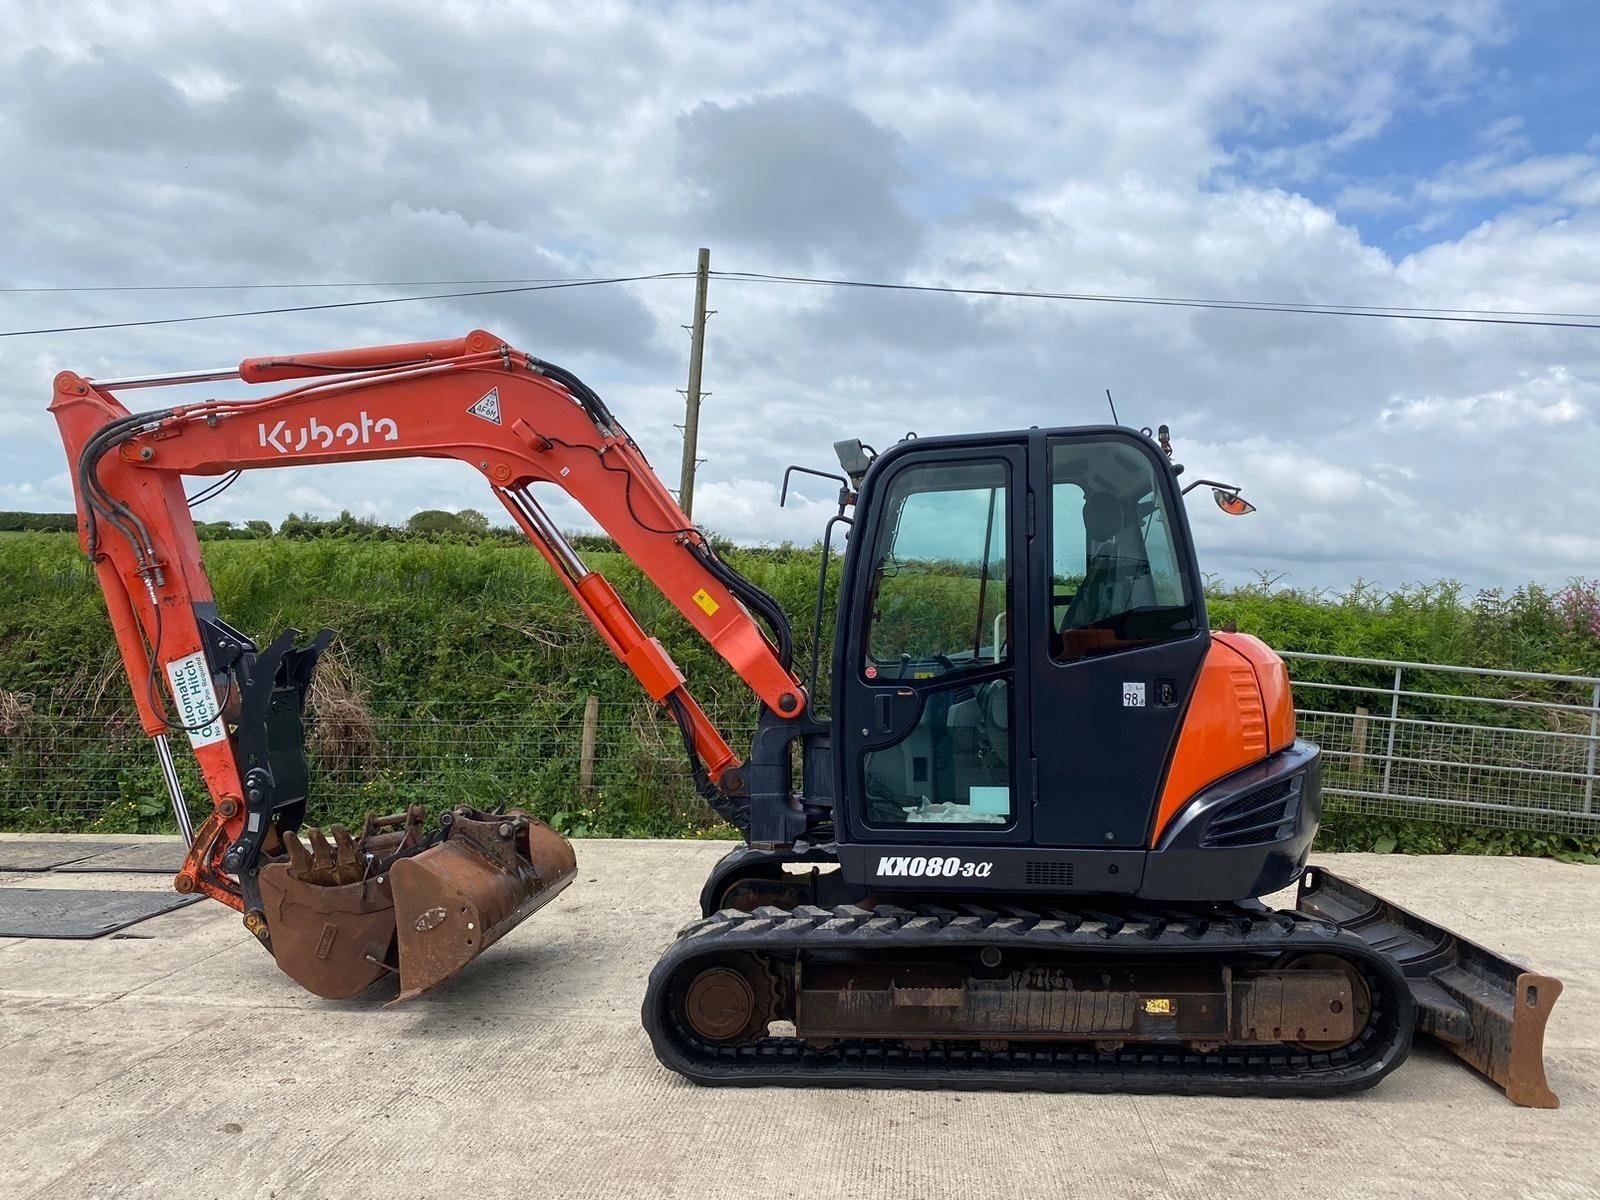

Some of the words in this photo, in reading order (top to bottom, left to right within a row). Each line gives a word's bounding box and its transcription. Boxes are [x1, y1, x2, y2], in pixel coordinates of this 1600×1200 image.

[484, 399, 495, 407] 19
[258, 411, 398, 453] Kubota
[185, 660, 201, 695] Hitch
[195, 656, 207, 687] Required
[175, 670, 199, 735] Automatic
[1124, 693, 1138, 705] 98
